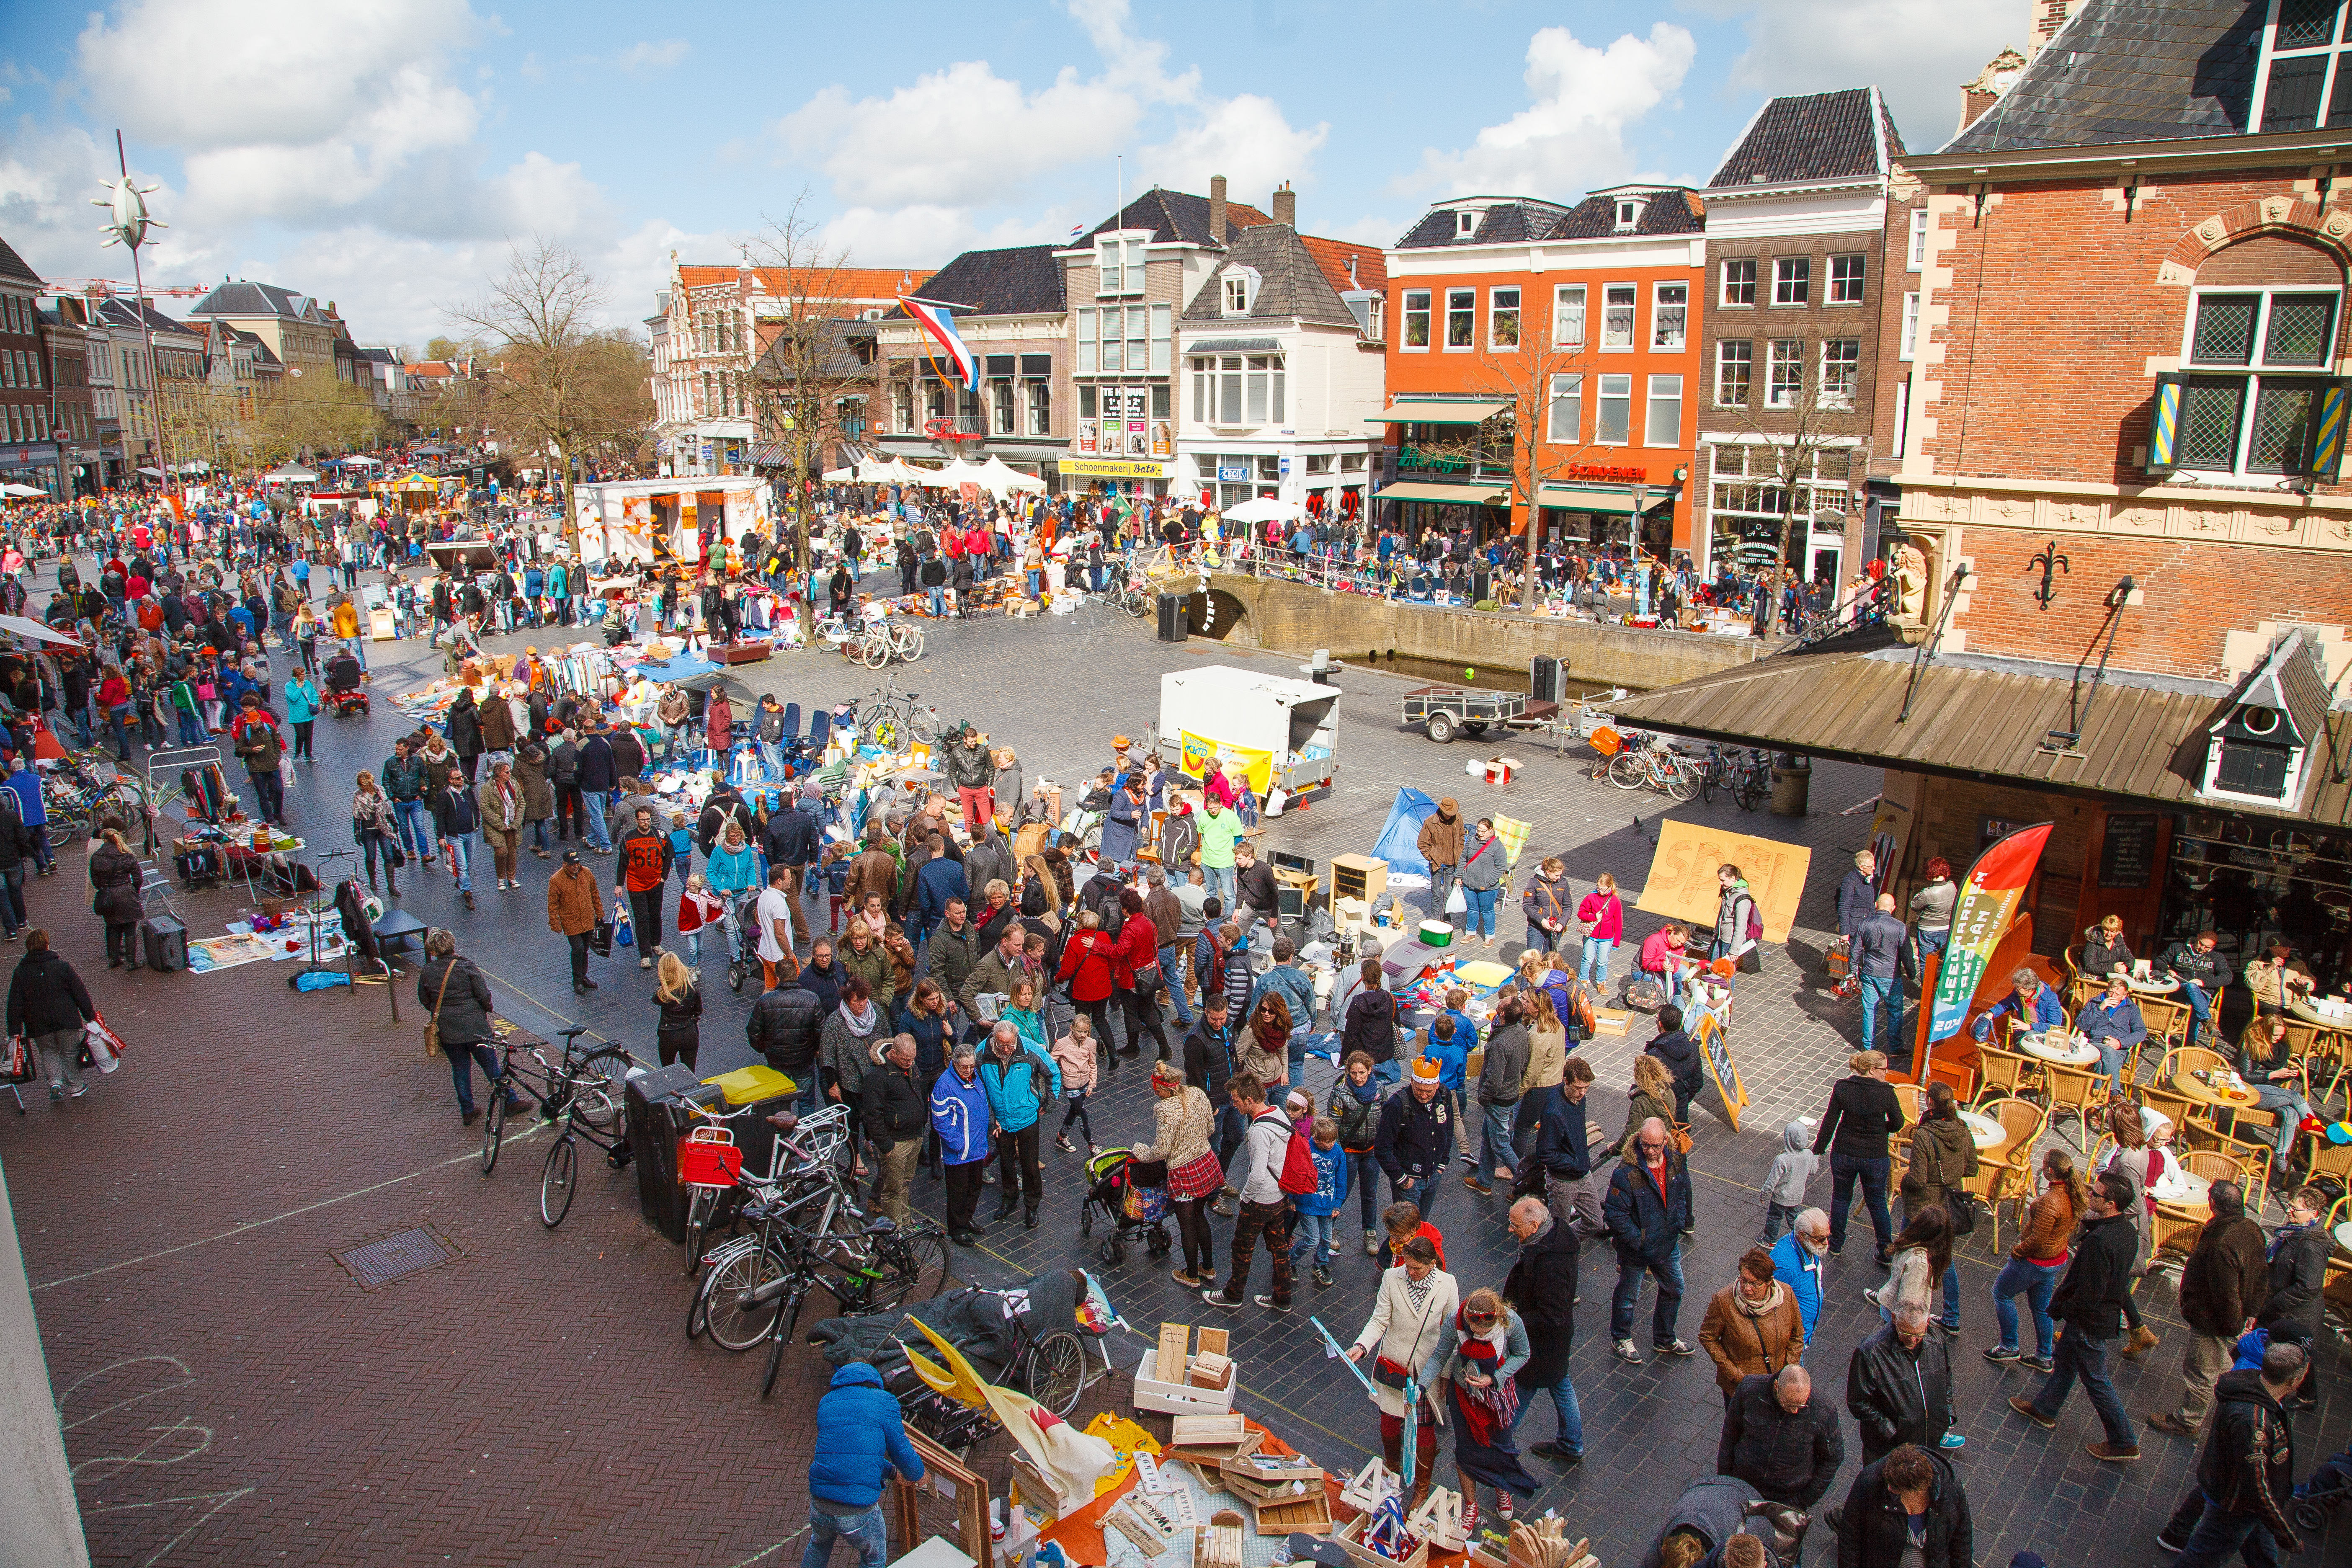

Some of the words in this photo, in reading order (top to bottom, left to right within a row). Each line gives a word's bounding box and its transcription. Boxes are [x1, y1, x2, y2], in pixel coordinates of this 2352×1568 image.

[1103, 388, 1113, 397] TE
[1075, 462, 1130, 475] Schoenmakerij
[1133, 464, 1155, 474] Bats
[1398, 447, 1465, 473] Ziengs
[1223, 470, 1243, 478] CECIL
[1570, 463, 1647, 478] SCHOENEN
[633, 846, 659, 867] 60
[1980, 931, 1995, 958] capital
[1992, 921, 2000, 930] of
[1996, 890, 2014, 919] culture
[1942, 872, 1988, 1002] LEEUWARDEN
